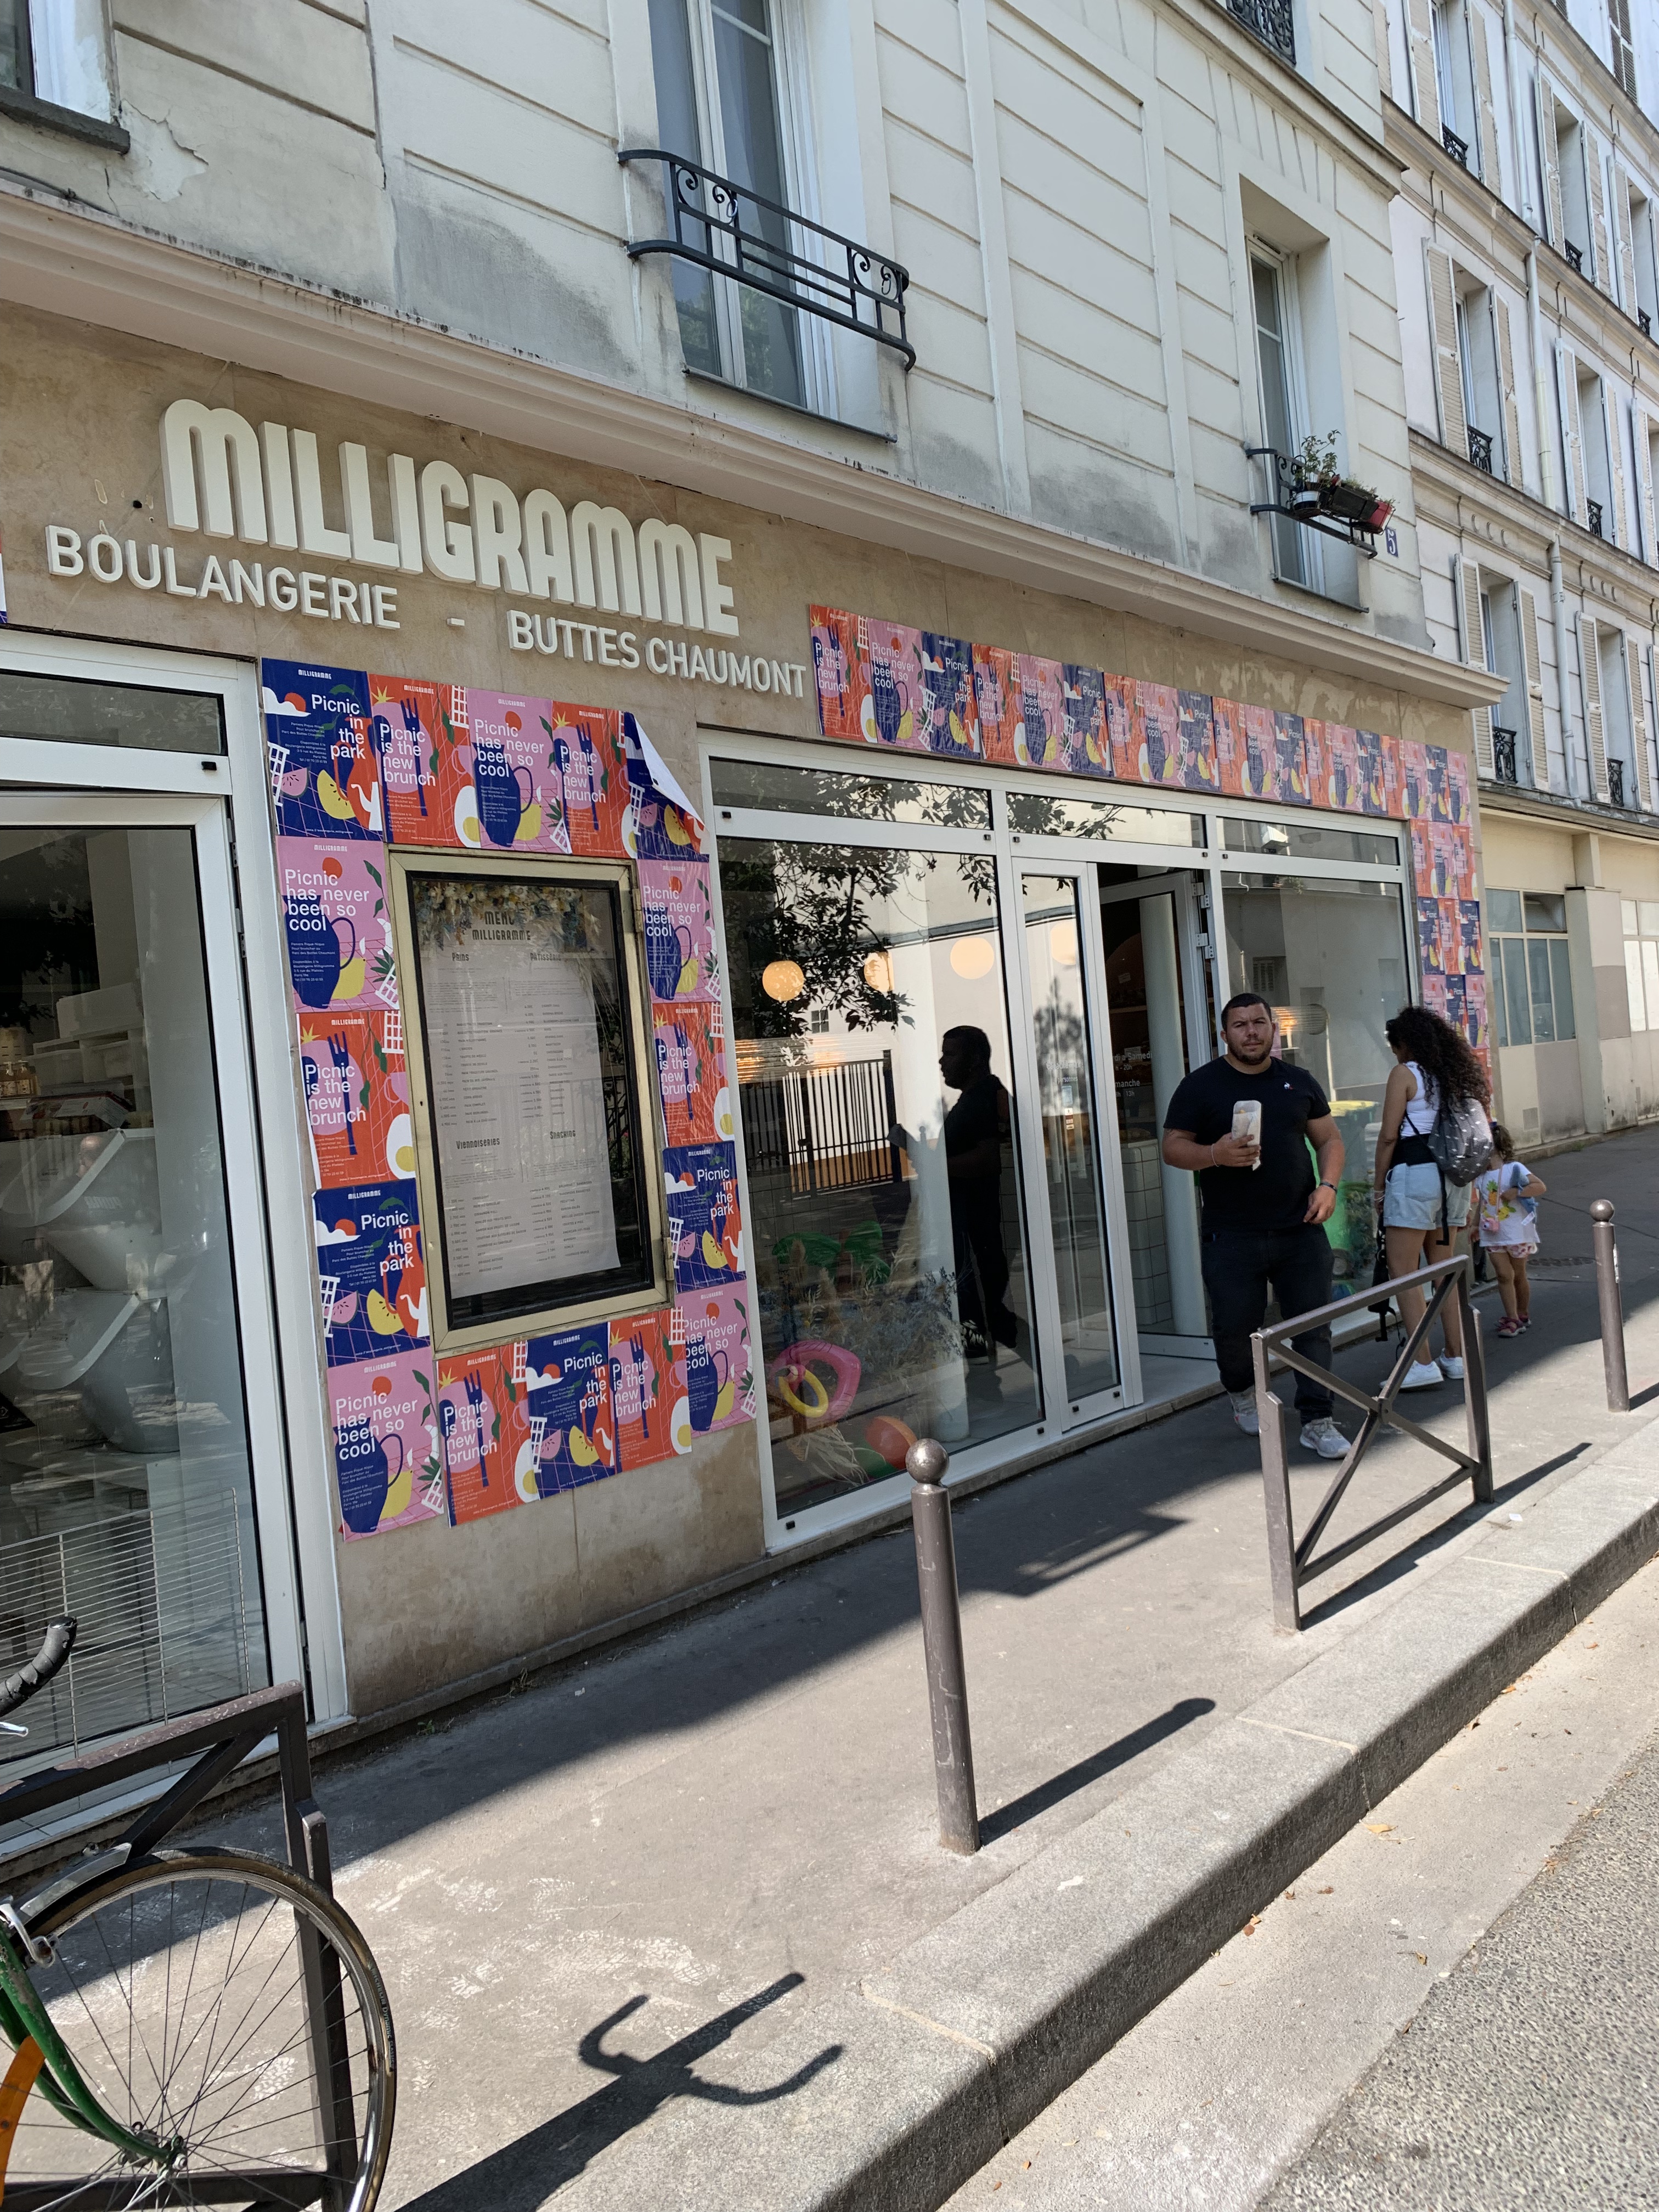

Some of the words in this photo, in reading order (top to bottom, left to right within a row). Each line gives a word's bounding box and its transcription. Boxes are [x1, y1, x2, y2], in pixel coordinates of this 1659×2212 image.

[159, 399, 739, 637] MILLIGRAMME
[1387, 529, 1396, 554] 5
[46, 525, 400, 629] BOULANGERIE
[446, 618, 465, 627] -
[506, 610, 640, 670] BUTTES
[645, 637, 806, 698] CHAUMONT
[815, 642, 843, 659] Picnic
[872, 642, 900, 658] Picnic
[816, 655, 824, 665] is
[826, 657, 840, 670] the
[873, 654, 889, 666] has
[891, 659, 915, 672] never
[946, 657, 969, 673] Picnic
[298, 669, 331, 679] MILLIGRAMME
[817, 668, 836, 679] new
[874, 666, 895, 679] been
[899, 672, 909, 681] so
[963, 673, 970, 682] in
[404, 685, 434, 695] MILLIGRAMME
[819, 677, 849, 693] brunch
[875, 678, 893, 689] cool
[959, 681, 971, 693] the
[977, 678, 1000, 691] Picnic
[1023, 675, 1045, 689] Picnic
[955, 693, 972, 704] park
[978, 690, 984, 699] is
[986, 691, 997, 701] the
[1023, 686, 1037, 697] has
[1039, 689, 1058, 700] never
[311, 694, 360, 714] Picnic
[498, 699, 526, 707] MILLIGRAMME
[979, 700, 993, 709] new
[1025, 696, 1042, 707] been
[579, 710, 605, 719] MILLIGRAMME
[980, 709, 1005, 722] brunch
[1025, 706, 1040, 716] cool
[349, 714, 363, 730] in
[475, 719, 518, 737] Picnic
[338, 729, 364, 744] the
[380, 723, 426, 743] Picnic
[381, 738, 394, 753] is
[398, 742, 421, 756] the
[476, 732, 503, 749] has
[506, 739, 544, 754] never
[330, 744, 366, 760] park
[478, 747, 512, 764] been
[517, 755, 533, 766] so
[561, 746, 597, 763] Picnic
[383, 757, 413, 769] new
[479, 763, 509, 777] cool
[562, 759, 572, 772] is
[574, 762, 594, 776] the
[384, 768, 436, 786] brunch
[563, 775, 587, 788] new
[565, 786, 606, 803] brunch
[285, 869, 338, 885] Picnic
[286, 884, 318, 900] has
[323, 888, 370, 901] never
[644, 885, 679, 900] Picnic
[288, 900, 331, 916] been
[337, 905, 356, 917] so
[644, 898, 665, 912] has
[669, 901, 701, 913] never
[289, 916, 326, 932] cool
[645, 911, 675, 925] been
[679, 915, 692, 925] so
[472, 929, 531, 940] MILLIGRAMME
[646, 924, 672, 937] cool
[658, 1045, 692, 1059] Picnic
[1128, 1051, 1152, 1060] Samedi
[305, 1062, 356, 1080] Picnic
[659, 1058, 669, 1070] is
[672, 1057, 689, 1069] the
[661, 1071, 682, 1083] new
[306, 1081, 320, 1095] is
[324, 1079, 351, 1093] the
[662, 1081, 700, 1096] brunch
[308, 1097, 341, 1110] new
[309, 1107, 366, 1126] brunch
[697, 1166, 730, 1183] Picnic
[722, 1178, 732, 1190] in
[348, 1189, 381, 1200] MILLIGRAMME
[715, 1190, 733, 1204] the
[361, 1210, 409, 1230] Picnic
[710, 1204, 734, 1221] park
[398, 1225, 412, 1240] in
[387, 1240, 413, 1256] the
[380, 1254, 414, 1276] park
[684, 1316, 716, 1330] Picnic
[707, 1322, 737, 1339] never
[553, 1334, 580, 1346] MILLIGRAMME
[716, 1340, 729, 1351] so
[364, 1361, 397, 1373] MILLIGRAMME
[466, 1354, 496, 1366] MILLIGRAMME
[564, 1351, 603, 1374] Picnic
[613, 1358, 648, 1378] Picnic
[686, 1353, 709, 1370] cool
[595, 1365, 606, 1378] in
[586, 1378, 607, 1393] the
[613, 1378, 623, 1391] is
[626, 1374, 645, 1388] the
[336, 1391, 387, 1414] Picnic
[579, 1392, 608, 1414] park
[614, 1389, 639, 1404] new
[337, 1412, 368, 1430] has
[373, 1399, 418, 1421] never
[444, 1399, 488, 1422] Picnic
[616, 1396, 657, 1418] brunch
[338, 1426, 380, 1446] been
[385, 1418, 404, 1434] so
[445, 1421, 458, 1437] is
[461, 1415, 484, 1431] the
[339, 1438, 375, 1460] cool
[447, 1434, 476, 1452] new
[448, 1439, 497, 1466] brunch
[371, 1967, 386, 2005] MICHELIN
[382, 2006, 392, 2039] Dynamic
